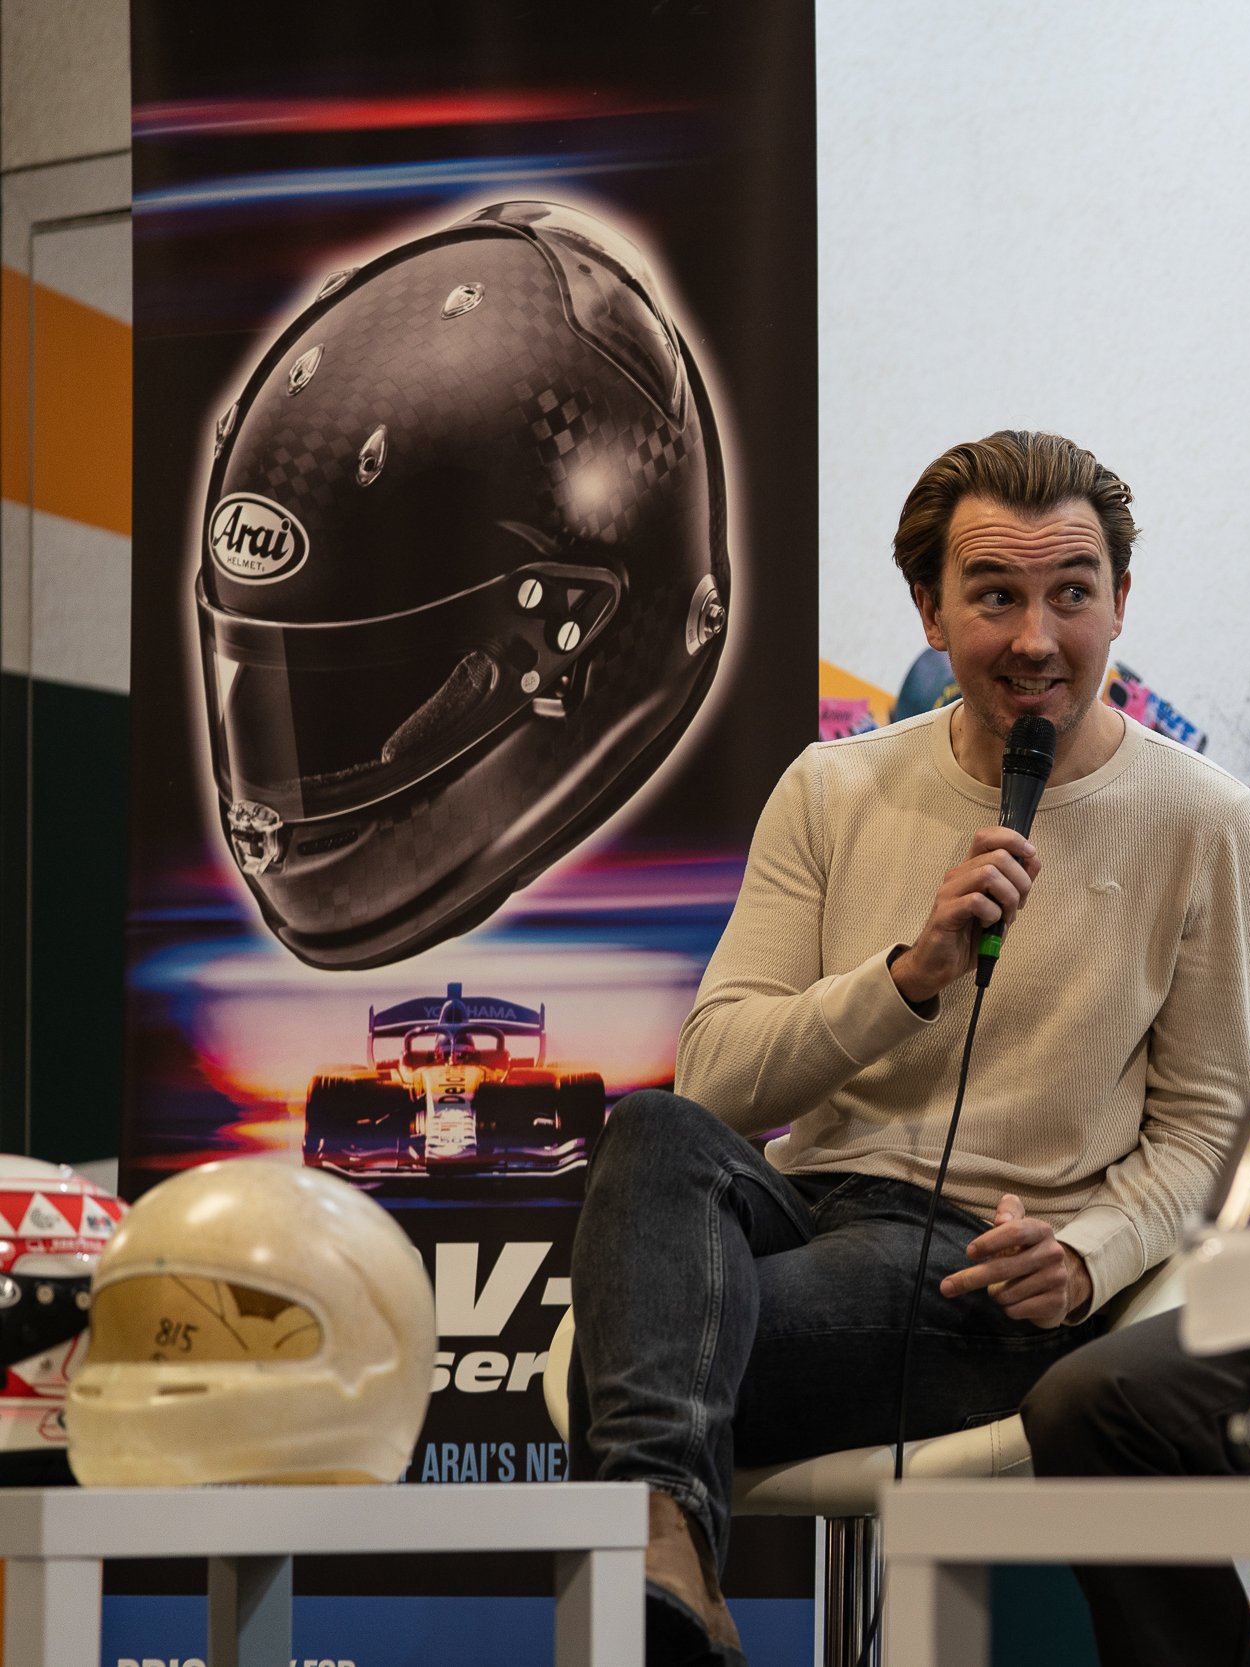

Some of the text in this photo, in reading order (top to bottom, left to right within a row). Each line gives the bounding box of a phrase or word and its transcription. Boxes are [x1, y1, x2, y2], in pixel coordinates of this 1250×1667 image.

[212, 504, 290, 561] Arai
[226, 555, 262, 571] HELMET
[423, 1004, 517, 1020] YOHAMA
[155, 1317, 199, 1354] 815
